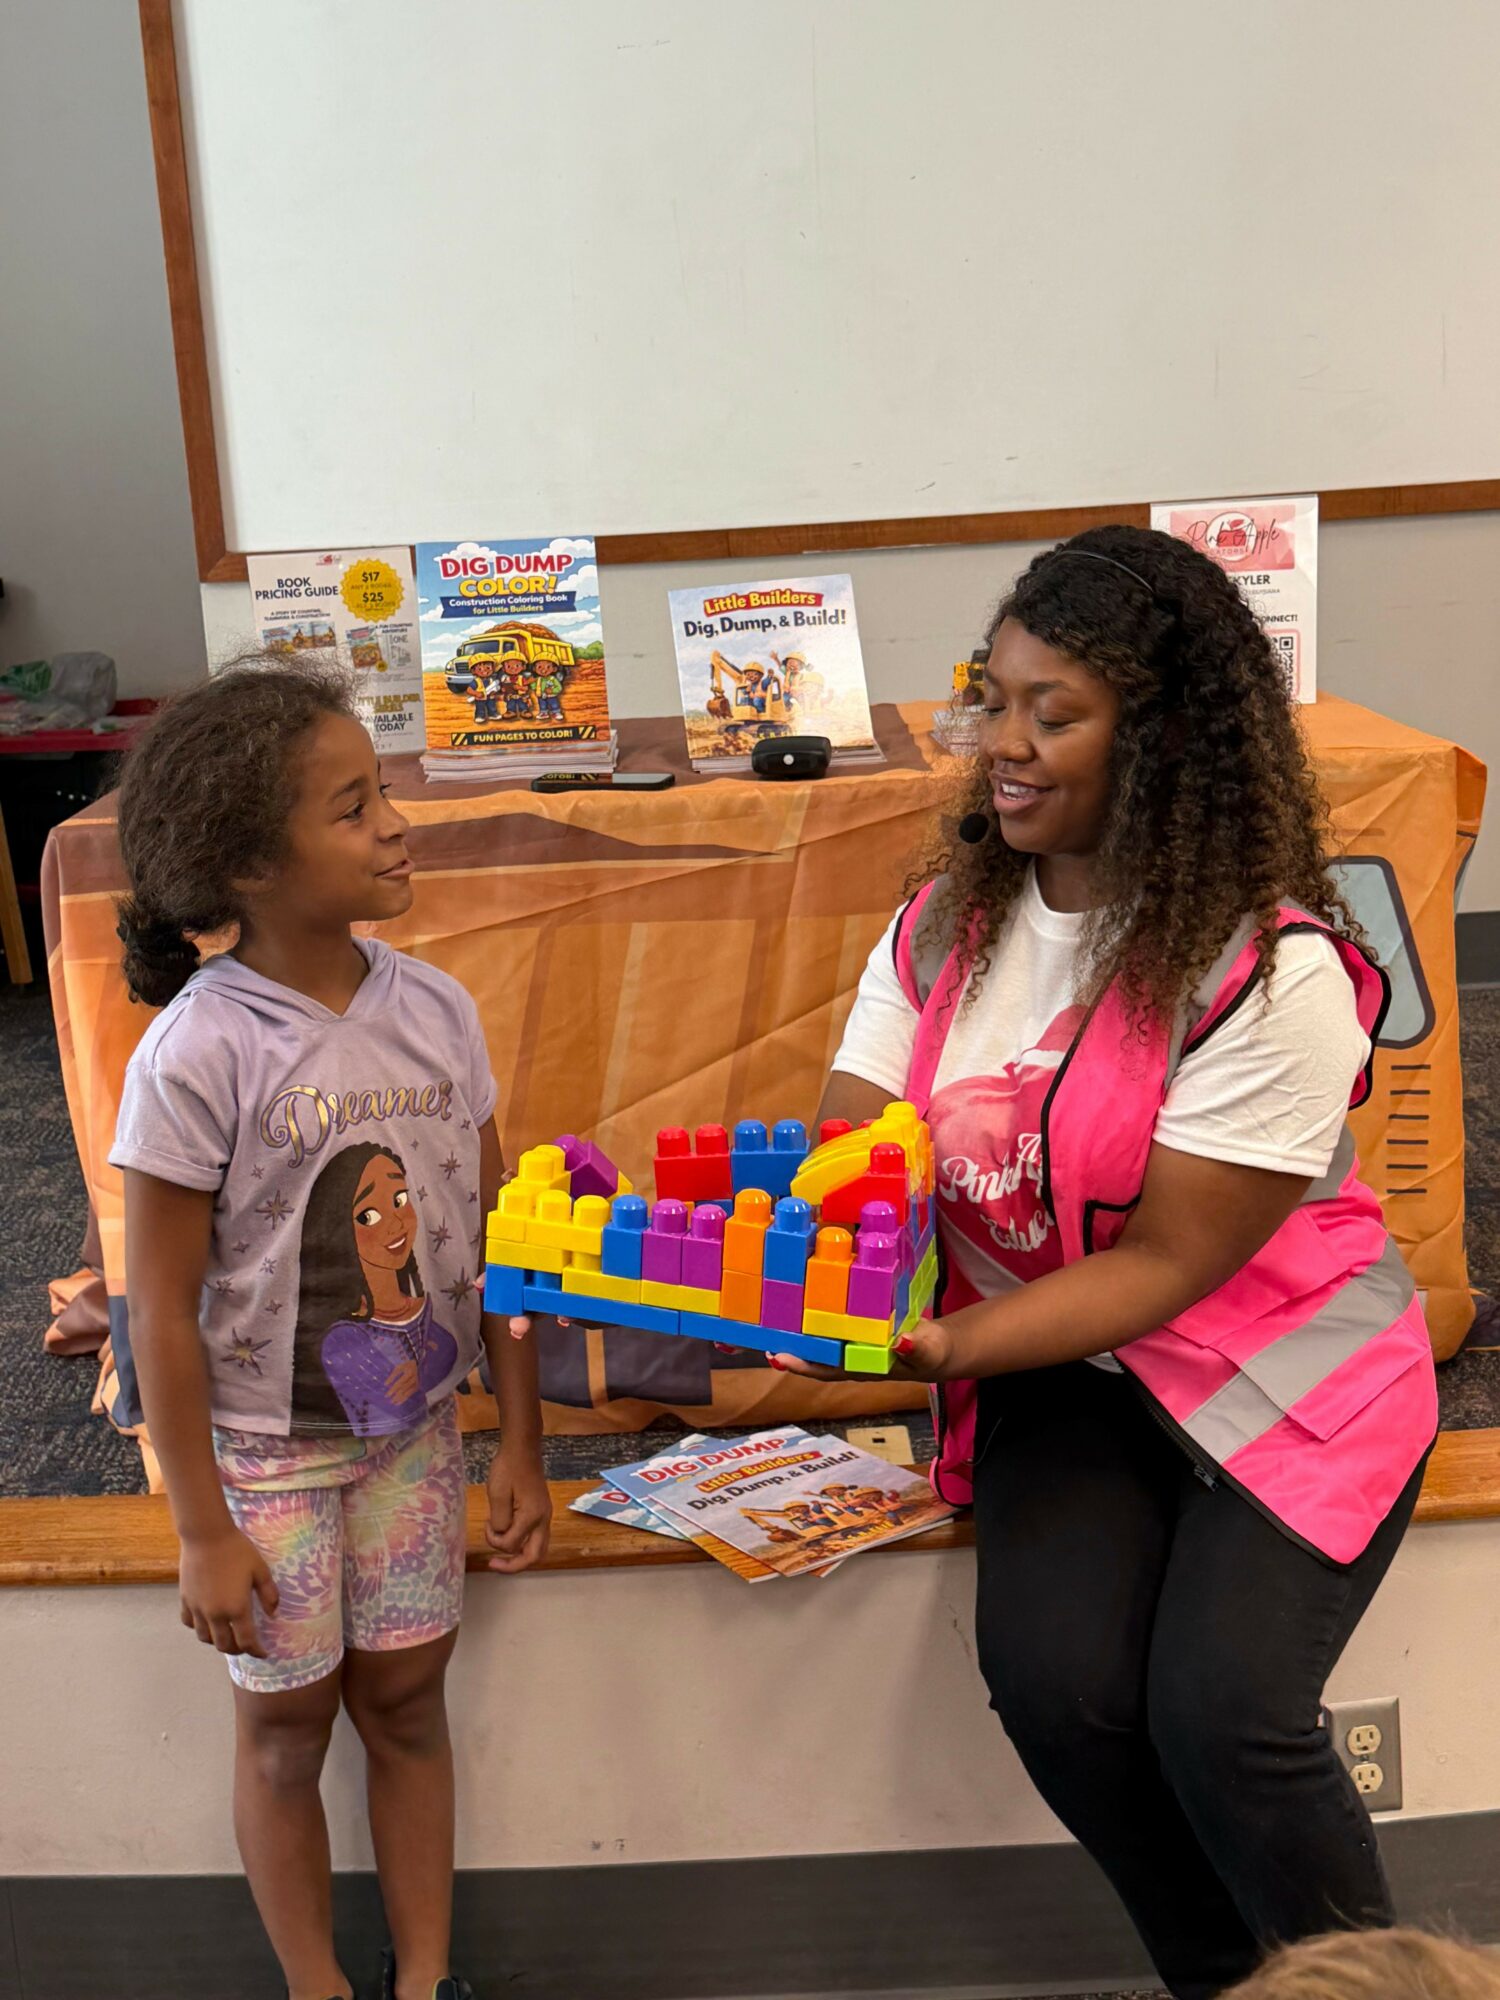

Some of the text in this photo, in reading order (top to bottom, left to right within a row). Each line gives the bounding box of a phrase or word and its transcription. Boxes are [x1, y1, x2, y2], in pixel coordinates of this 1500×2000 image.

[362, 571, 380, 583] $17
[441, 554, 573, 578] DIG DUMP
[255, 585, 339, 600] PRICING GUIDE
[277, 577, 311, 588] BOOK
[459, 575, 557, 598] COLOR!
[362, 592, 384, 603] $25
[449, 594, 568, 607] Construction Coloring Book
[704, 589, 816, 615] Little Builders
[473, 604, 544, 615] for Little Builders
[1257, 614, 1298, 622] ONNECT!
[683, 609, 847, 638] Dig, Dump, & Build!
[474, 730, 573, 743] FUN PAGES TO COLOR!
[260, 1079, 454, 1169] Dreamer
[938, 1151, 1023, 1204] Pink
[640, 1461, 698, 1483] DIG
[698, 1438, 785, 1466] DUMP
[697, 1472, 743, 1492] Little
[741, 1452, 814, 1477] Builders
[687, 1494, 732, 1510] Dig,
[726, 1475, 791, 1497] Dump,
[790, 1470, 803, 1478] &
[799, 1451, 860, 1473] Build!
